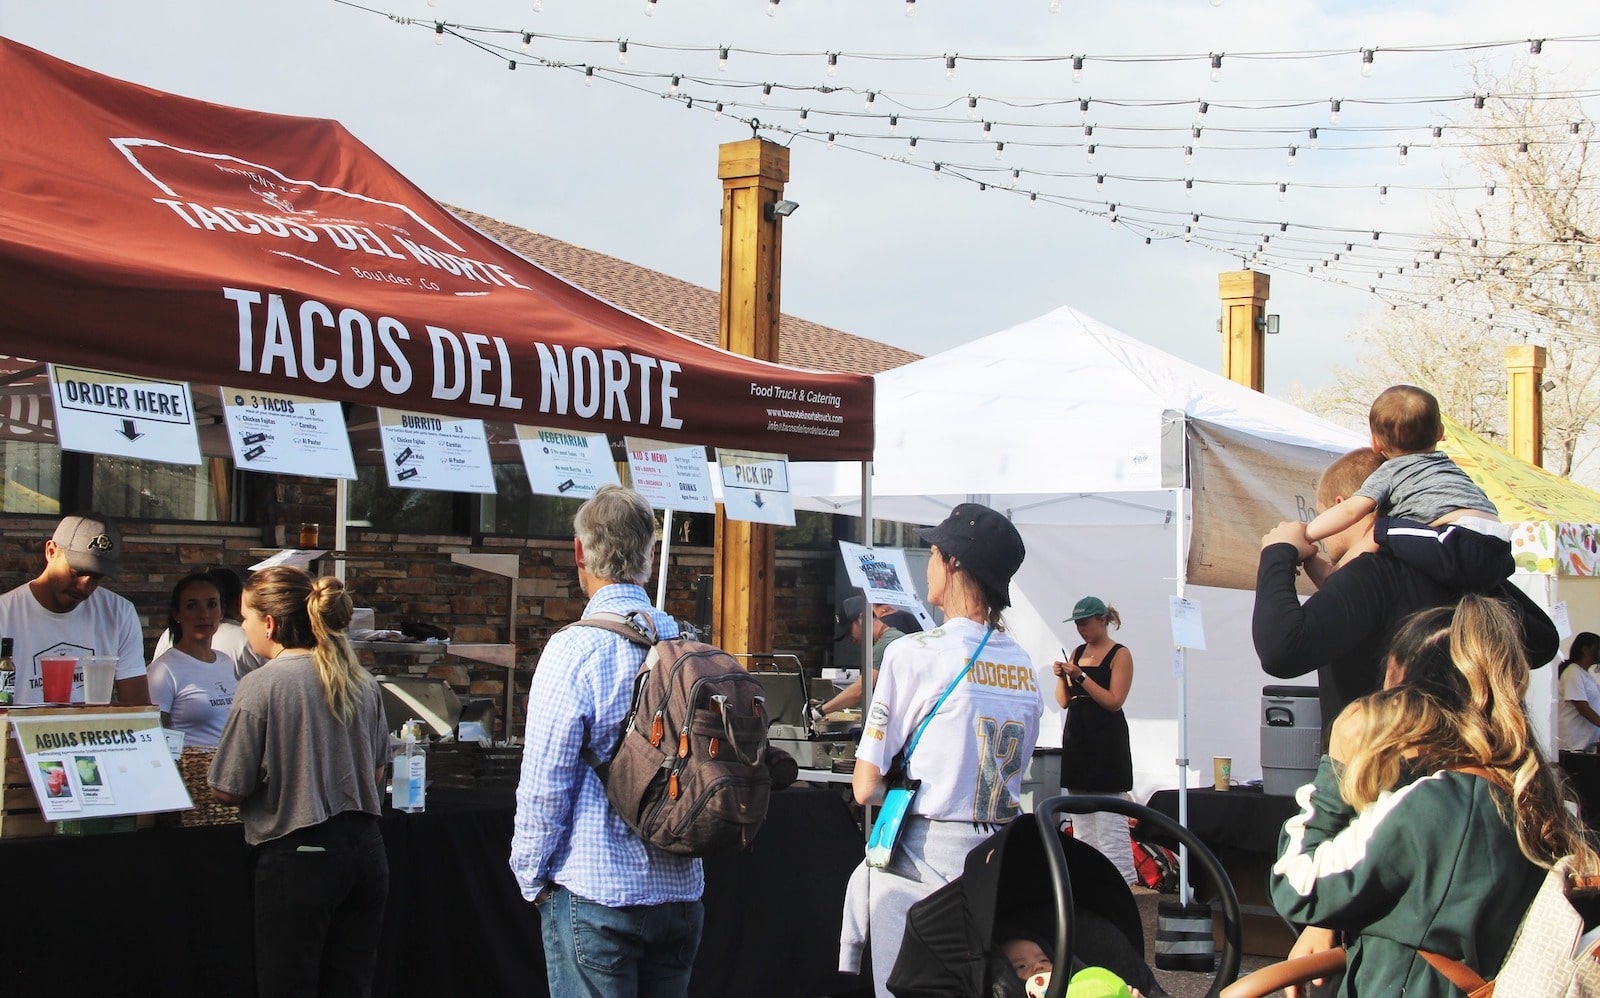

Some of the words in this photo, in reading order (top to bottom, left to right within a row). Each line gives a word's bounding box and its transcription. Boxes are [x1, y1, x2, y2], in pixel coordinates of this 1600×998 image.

[152, 197, 318, 242] TACOS
[309, 223, 406, 261] DEL
[393, 234, 533, 291] NORTE
[351, 265, 412, 289] Boulder
[223, 287, 413, 395] TACOS
[425, 325, 523, 410] DEL
[534, 341, 683, 430] NORTE
[65, 379, 129, 410] ORDER
[135, 388, 183, 418] HERE
[250, 395, 259, 409] 3
[260, 396, 295, 414] TACOS
[750, 382, 773, 397] Food
[774, 386, 797, 400] Truck
[798, 389, 805, 402] &
[806, 390, 842, 409] Catering
[242, 415, 261, 423] Chicken
[260, 417, 276, 425] Fajitas
[401, 414, 442, 431] BURRITO
[538, 430, 589, 448] VEGETARIAN
[632, 450, 650, 461] KID'S
[651, 452, 668, 463] MENU
[735, 464, 759, 484] PICK
[760, 467, 773, 485] UP
[679, 482, 697, 491] DRINKS
[858, 553, 875, 562] HELP
[859, 561, 887, 572] WANTED
[29, 677, 43, 689] TAC
[964, 658, 1037, 692] RODGERS
[35, 732, 79, 749] AGUAS
[79, 729, 137, 746] FRESCAS
[140, 734, 152, 742] 3.5
[973, 716, 1025, 824] 12
